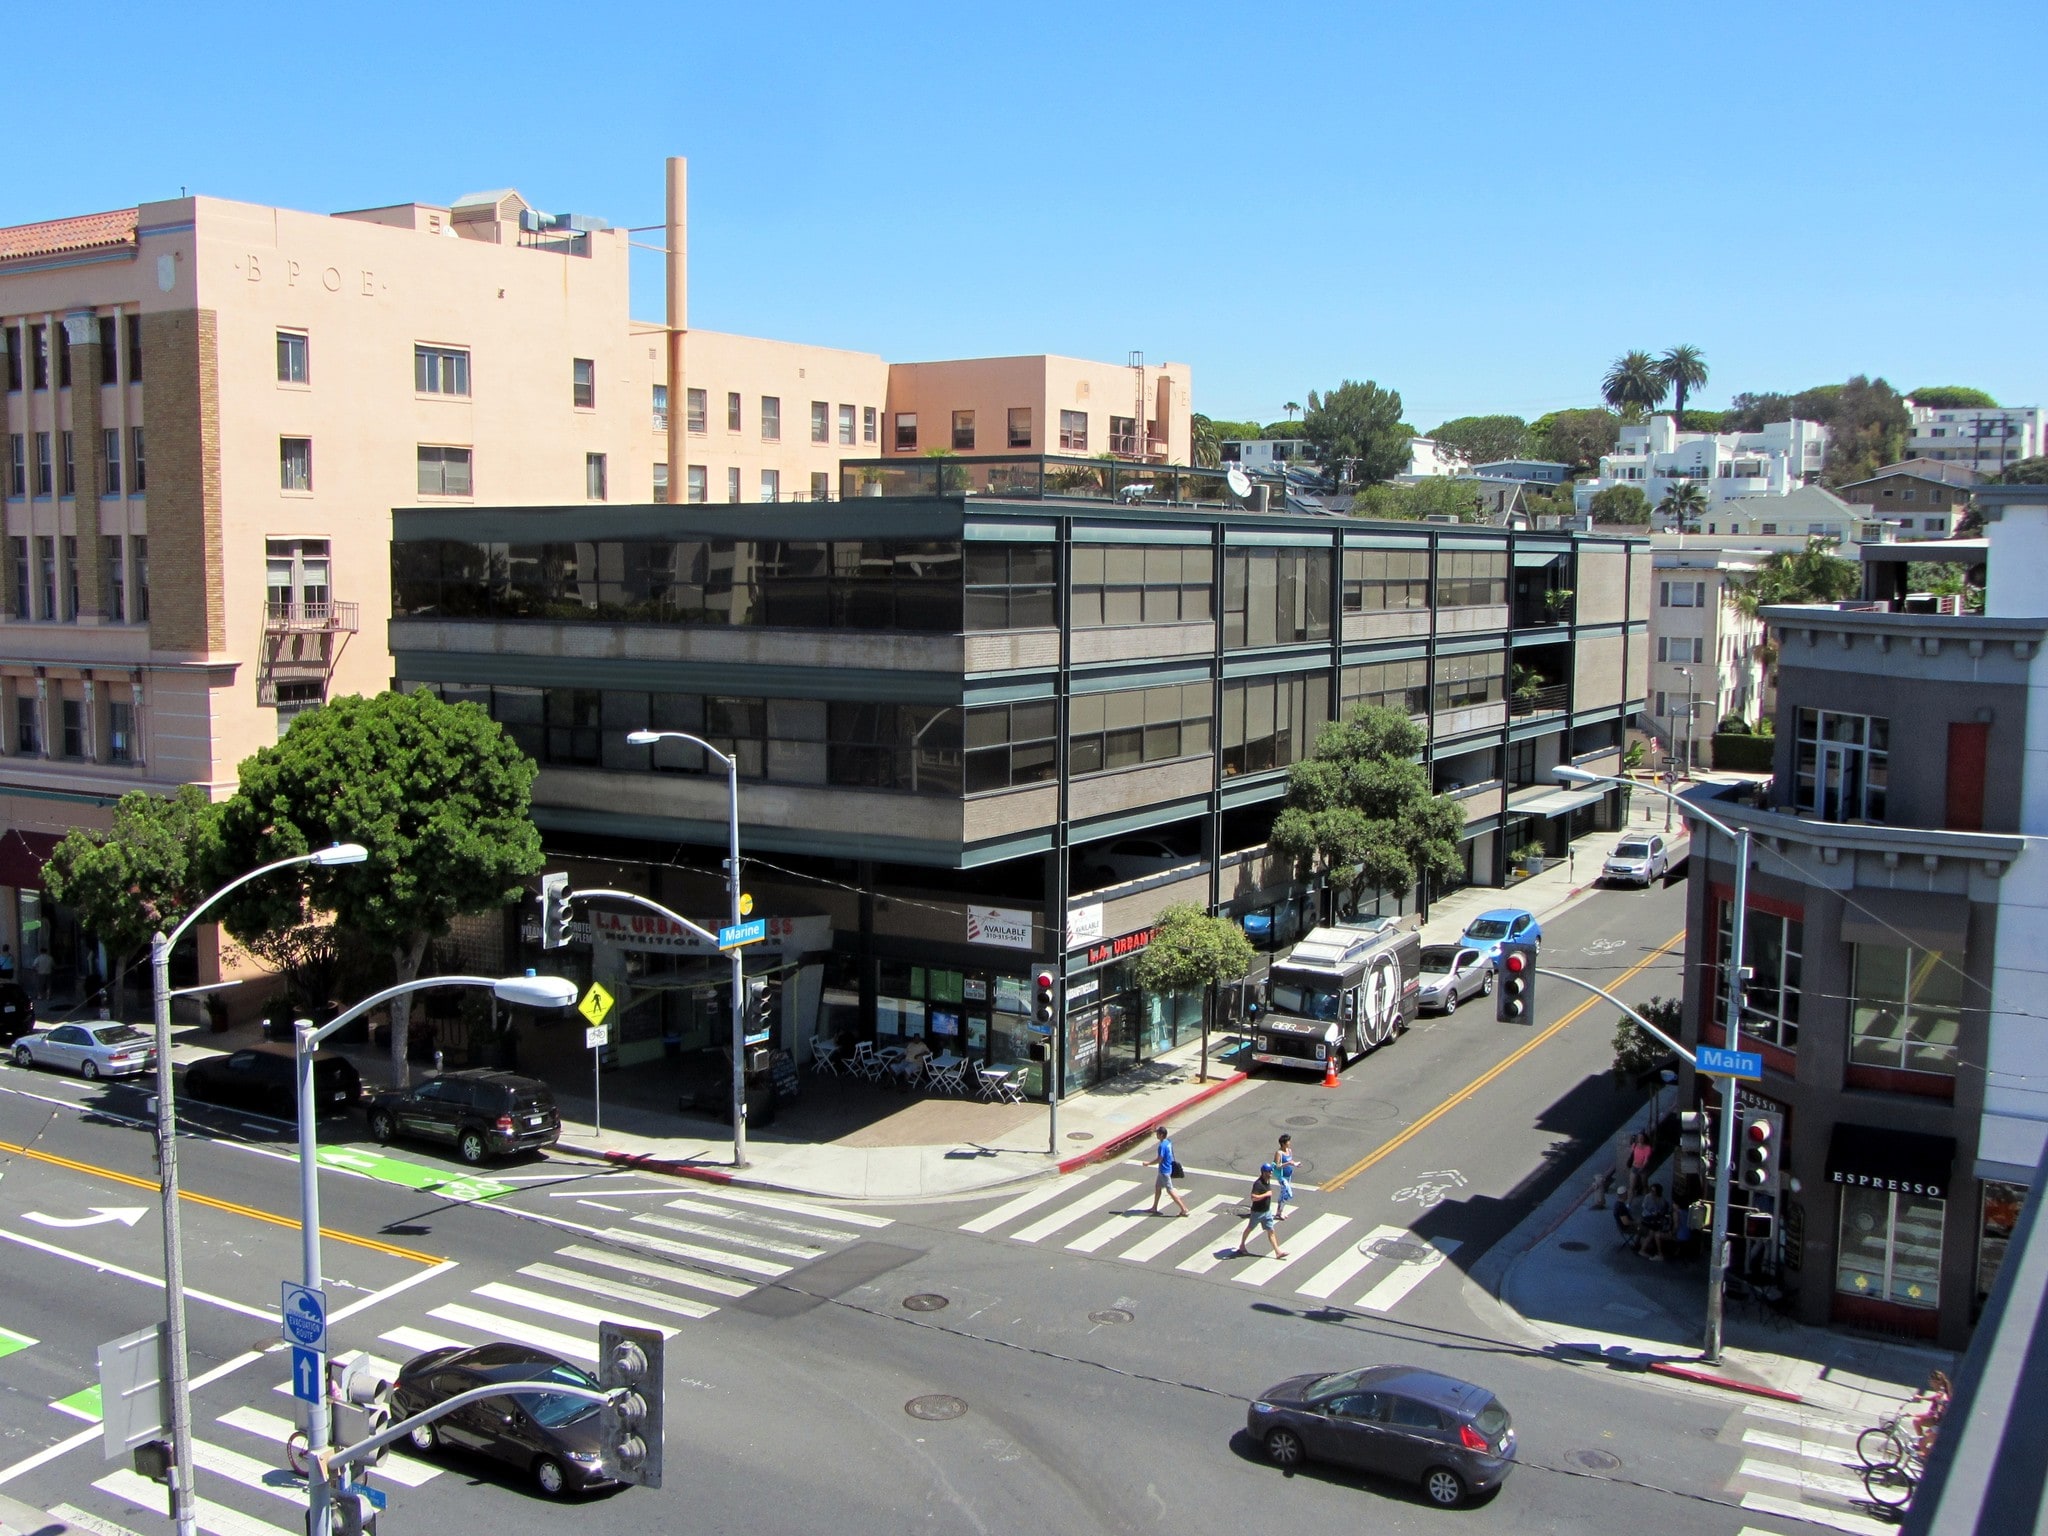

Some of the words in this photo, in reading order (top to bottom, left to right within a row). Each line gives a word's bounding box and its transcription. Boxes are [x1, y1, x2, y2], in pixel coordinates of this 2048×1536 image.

[595, 912, 627, 931] L.A.
[983, 924, 1027, 937] AVAILABLE
[605, 931, 700, 947] NUTRITION
[725, 925, 760, 942] Marine
[1089, 944, 1110, 963] L.A.
[1113, 931, 1149, 955] URBAN
[1703, 1050, 1754, 1071] Main
[1735, 1087, 1776, 1112] PRESSO
[1833, 1171, 1941, 1196] ESPRESSO
[289, 1315, 320, 1332] EVACUATION
[296, 1327, 313, 1341] ROUTE
